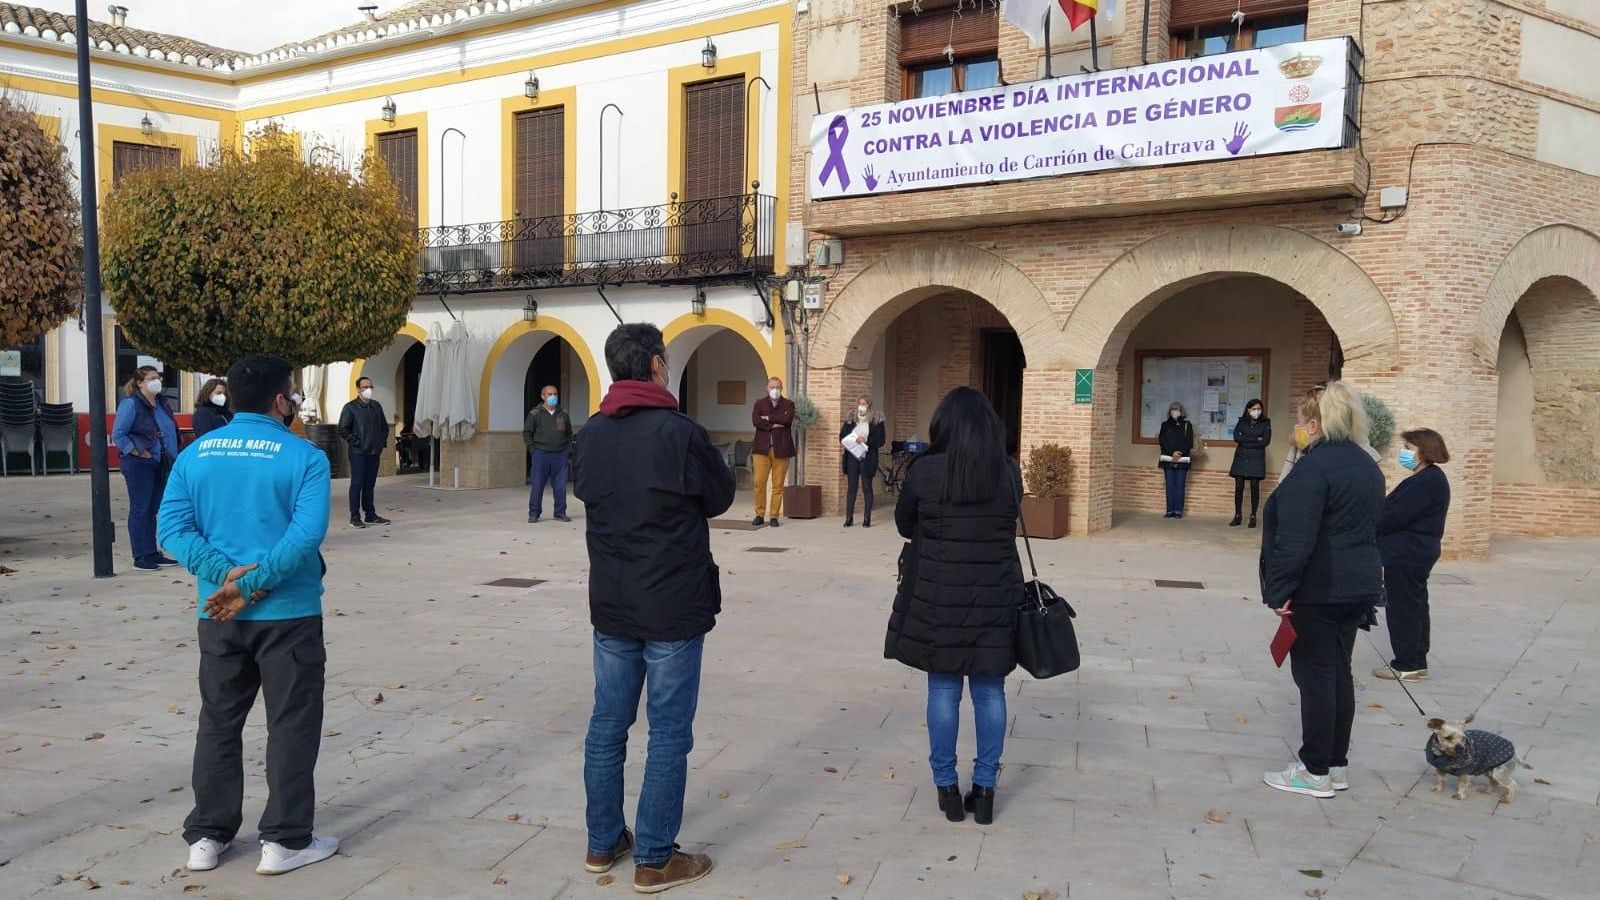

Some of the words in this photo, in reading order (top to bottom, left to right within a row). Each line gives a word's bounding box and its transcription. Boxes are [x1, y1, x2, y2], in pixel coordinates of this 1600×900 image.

[861, 111, 881, 128] 25
[888, 94, 1005, 124] NOVIEMBRE
[1013, 86, 1049, 108] DÍA
[1056, 58, 1259, 101] INTERNACIONAL
[863, 132, 942, 155] CONTRA
[948, 128, 973, 146] LA
[980, 112, 1098, 142] VIOLENCIA
[1106, 107, 1137, 127] DE
[1145, 93, 1252, 121] GÉNERO
[887, 162, 994, 187] Ayuntamiento
[999, 157, 1018, 173] de
[1023, 149, 1087, 170] Carrión
[1094, 145, 1114, 162] de
[1120, 138, 1215, 160] Calatrava
[198, 438, 243, 451] FRUTERIAS
[245, 439, 282, 453] MARTIN
